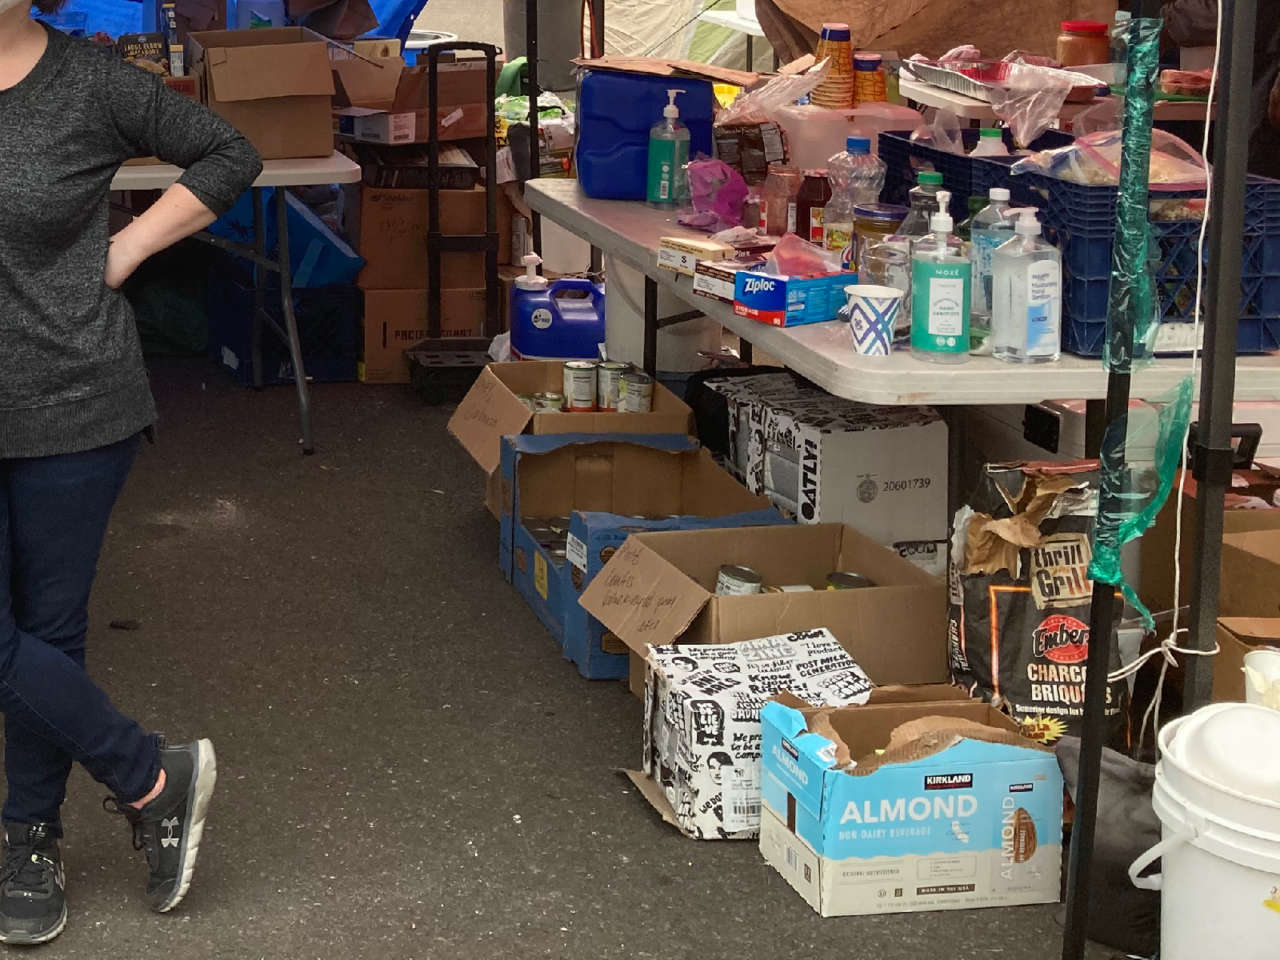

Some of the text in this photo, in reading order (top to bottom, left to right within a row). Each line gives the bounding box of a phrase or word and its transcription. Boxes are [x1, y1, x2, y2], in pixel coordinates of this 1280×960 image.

[744, 277, 776, 295] Ziploc
[801, 438, 818, 520] OATLY!
[882, 477, 931, 492] 20601739
[1033, 544, 1083, 568] thrill
[1032, 623, 1090, 658] Ember
[796, 660, 818, 671] POST
[820, 654, 848, 664] MILK
[748, 673, 791, 682] Know
[735, 752, 761, 762] comp
[926, 774, 971, 785] KIRKLAND
[839, 794, 978, 825] ALMOND
[1000, 796, 1015, 880] ALMOND
